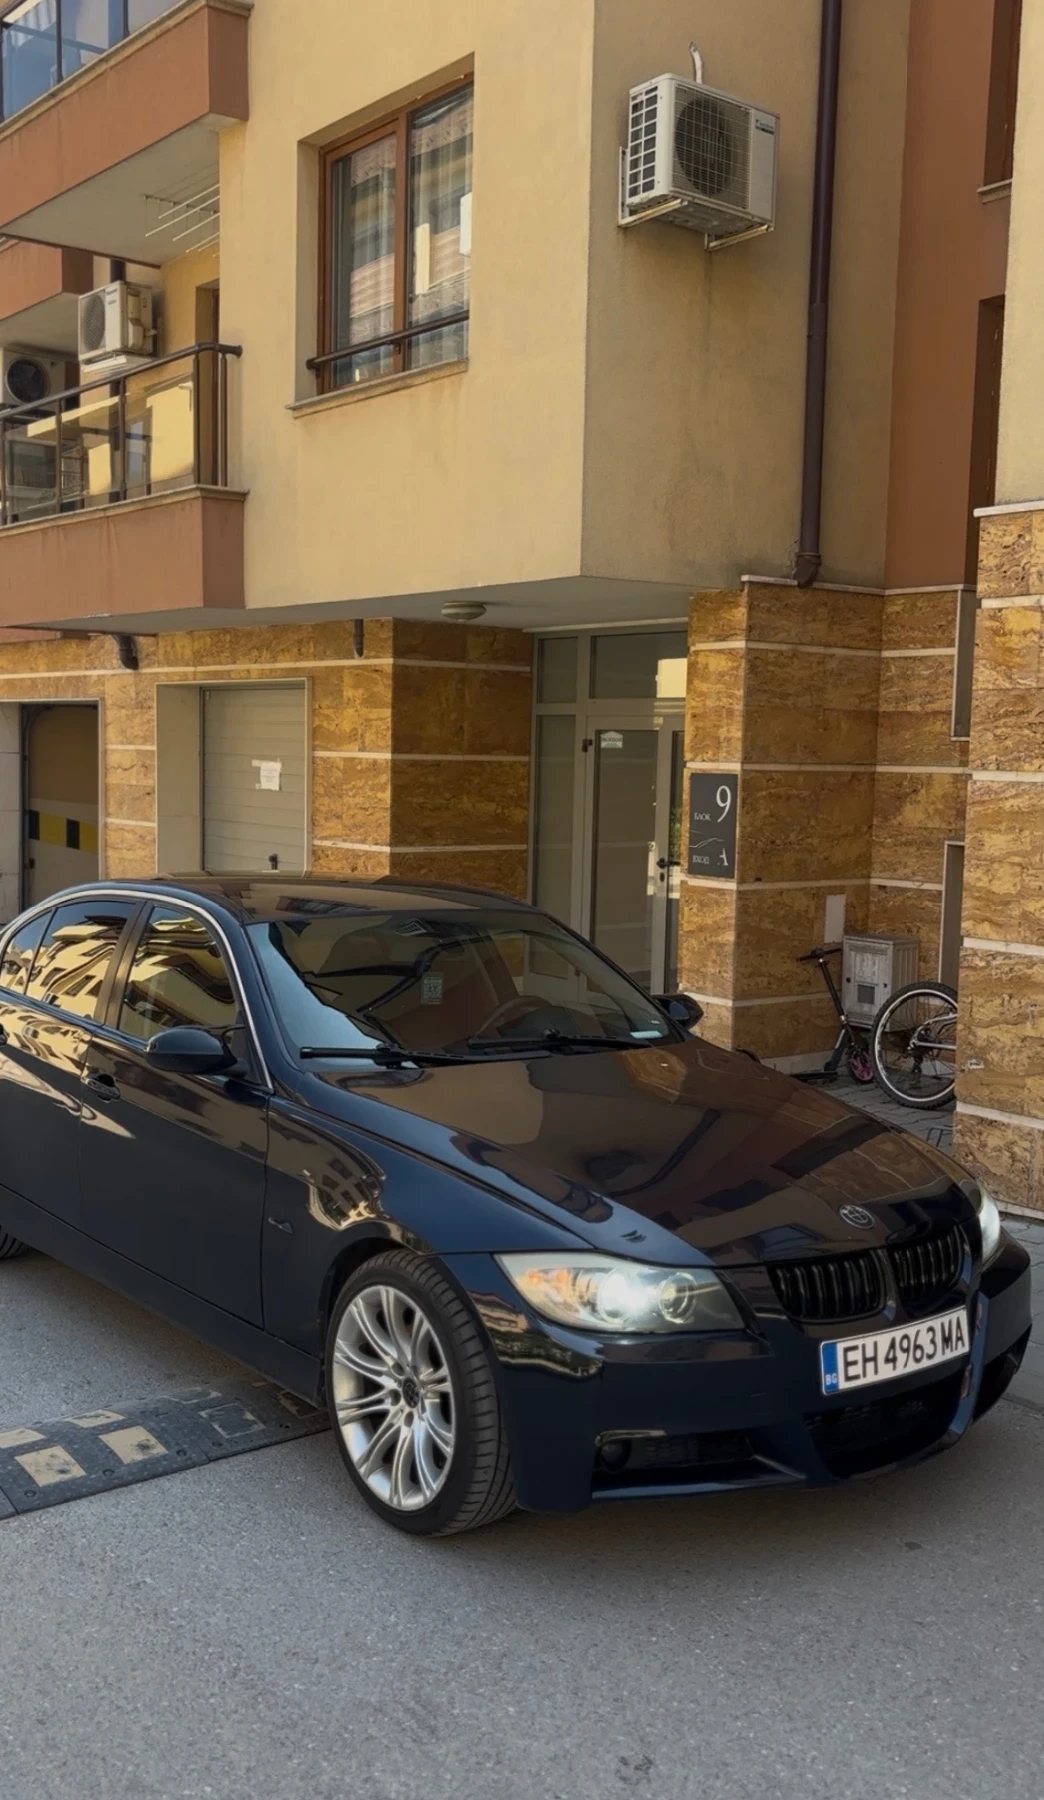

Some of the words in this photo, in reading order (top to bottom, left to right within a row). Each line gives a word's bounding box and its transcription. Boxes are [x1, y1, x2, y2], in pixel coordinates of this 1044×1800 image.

[694, 812, 712, 821] БЛОК
[716, 785, 732, 823] 9
[842, 1340, 879, 1383] EH
[884, 1325, 938, 1372] 4963
[940, 1315, 966, 1356] MA
[825, 1373, 838, 1386] BG
